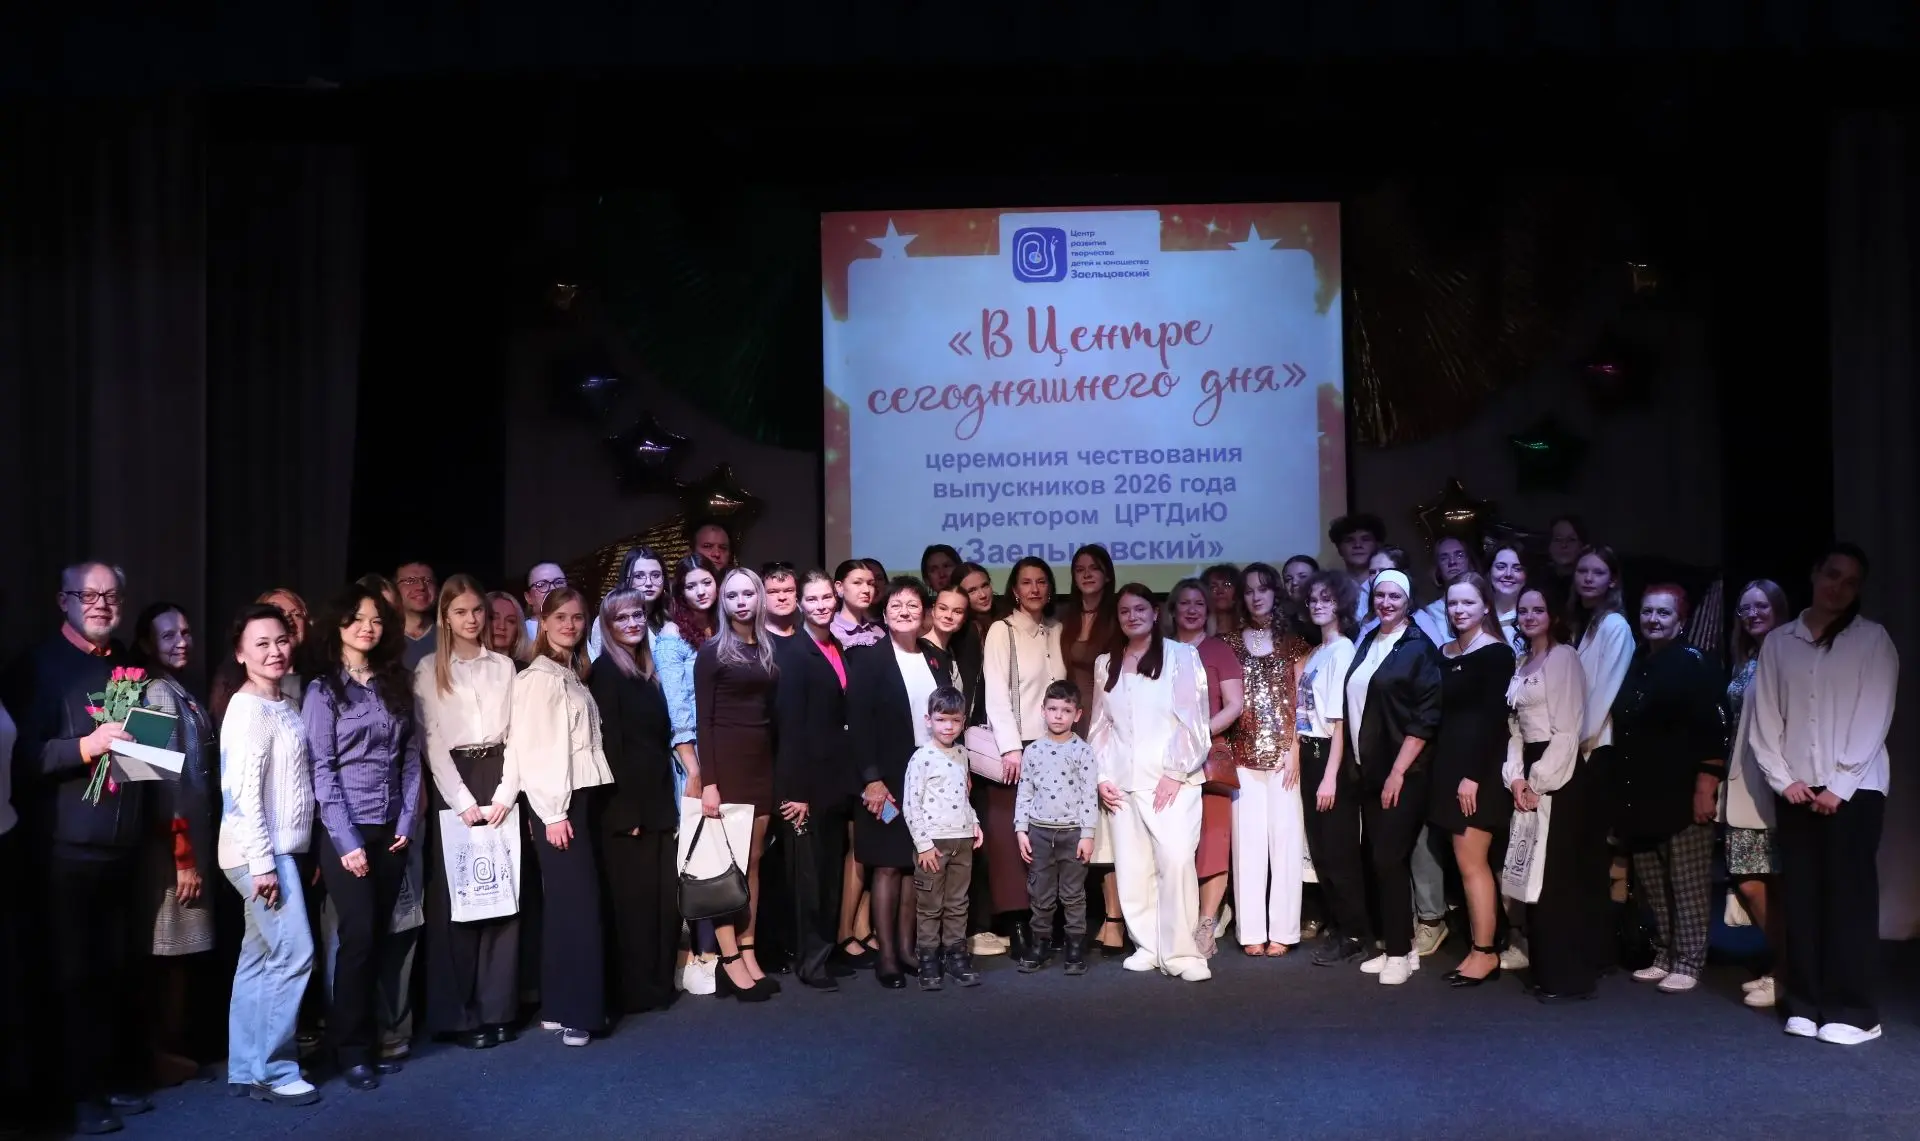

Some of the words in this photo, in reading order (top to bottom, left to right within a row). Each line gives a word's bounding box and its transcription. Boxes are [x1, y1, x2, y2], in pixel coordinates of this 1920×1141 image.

[1070, 229, 1095, 237] Центр
[1070, 268, 1150, 279] Заельцовский
[1071, 259, 1094, 267] детей
[1026, 305, 1213, 370] Центре
[867, 371, 1180, 441] сегодняшнего
[1192, 362, 1307, 427] дня»
[925, 450, 1069, 474] церемония
[1076, 446, 1243, 465] чествования
[933, 479, 1106, 503] выпускников
[1113, 473, 1172, 494] 2026
[1180, 476, 1237, 496] года
[941, 508, 1099, 533] директором
[1115, 501, 1228, 528] ЦРТДиЮ
